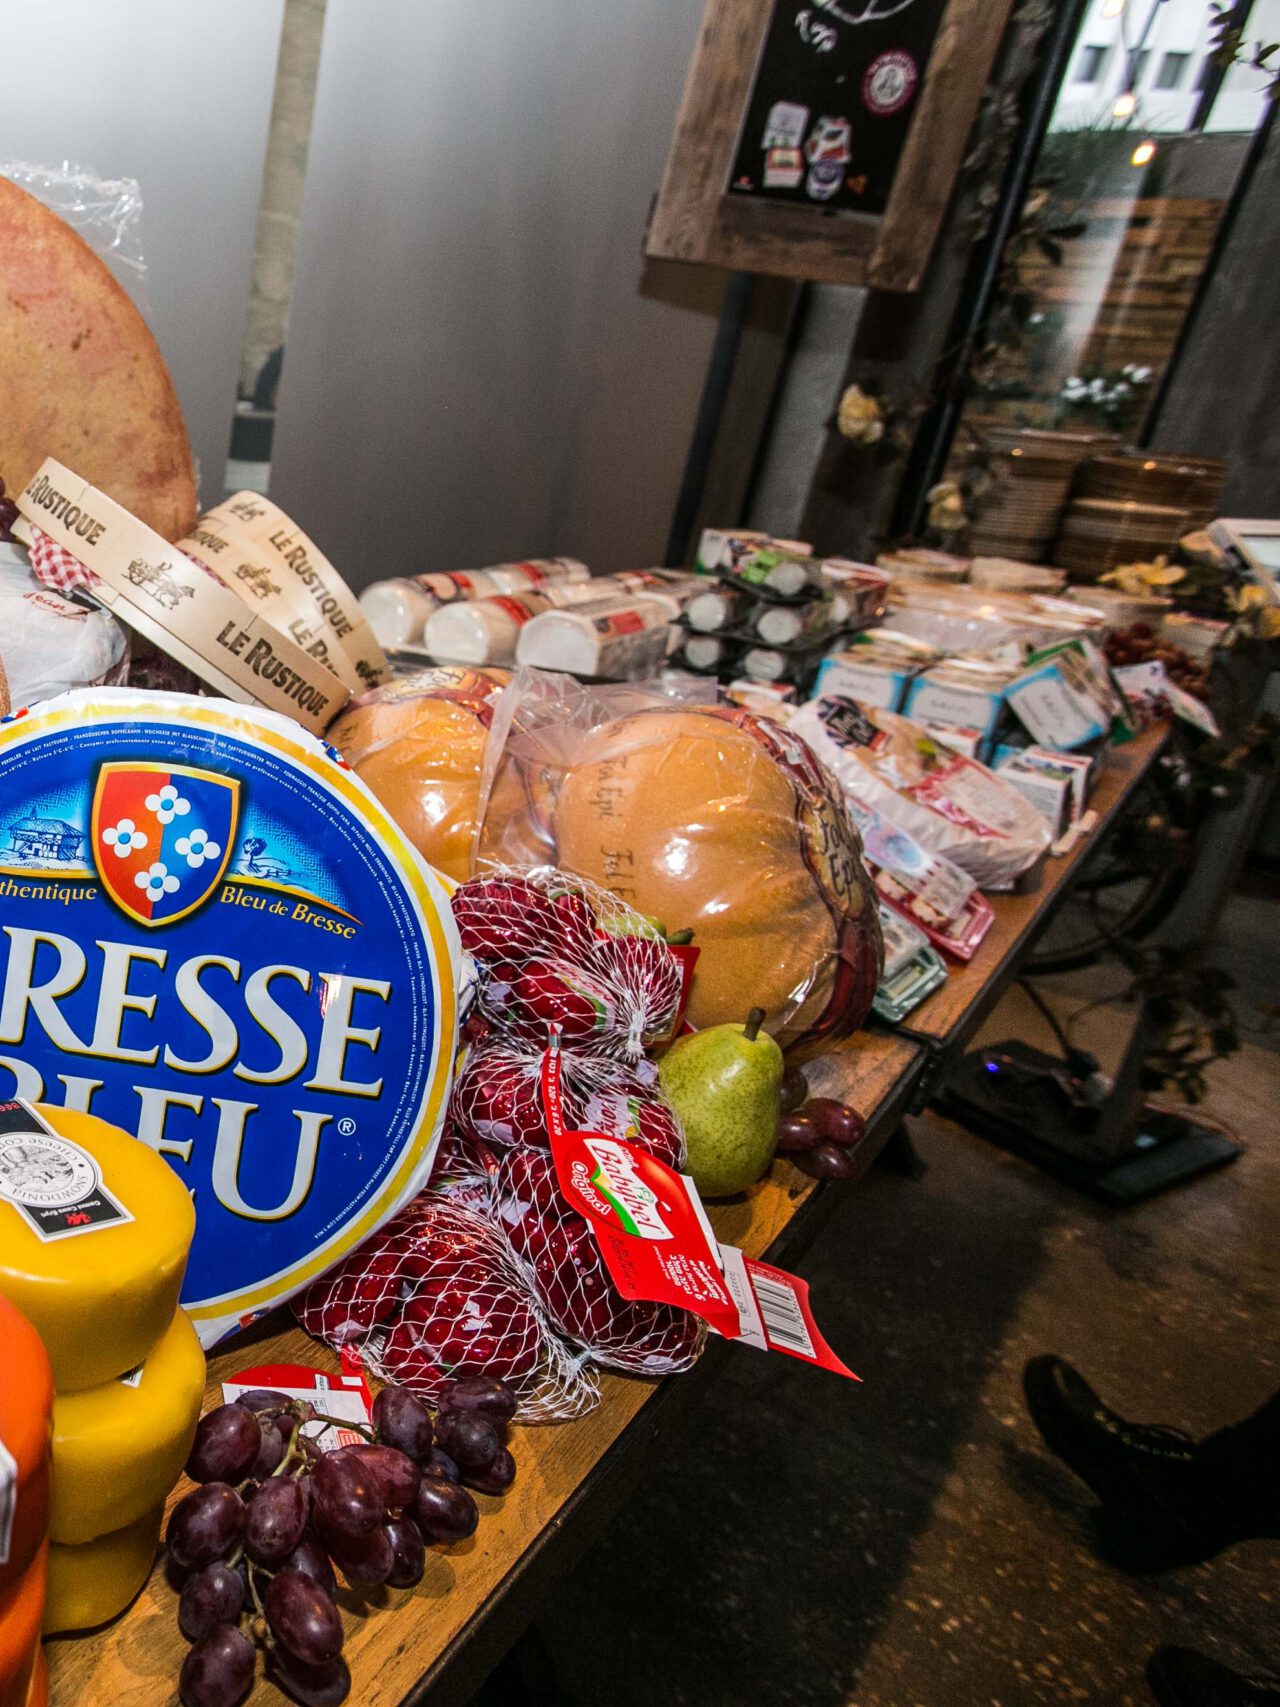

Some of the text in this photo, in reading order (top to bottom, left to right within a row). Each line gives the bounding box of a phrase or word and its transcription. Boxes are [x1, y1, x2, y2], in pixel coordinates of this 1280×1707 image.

[32, 476, 106, 547] RUSTIQUE
[269, 530, 291, 553] LE
[284, 544, 354, 640] RUSTIQUE
[289, 618, 313, 645] LE
[216, 620, 249, 656] LE
[245, 638, 329, 717] RUSTIQUE
[220, 885, 357, 940] Bleu de Bresse
[12, 1174, 88, 1202] SNOWDONIA
[570, 1161, 612, 1216] Original
[591, 1145, 662, 1234] Babybel
